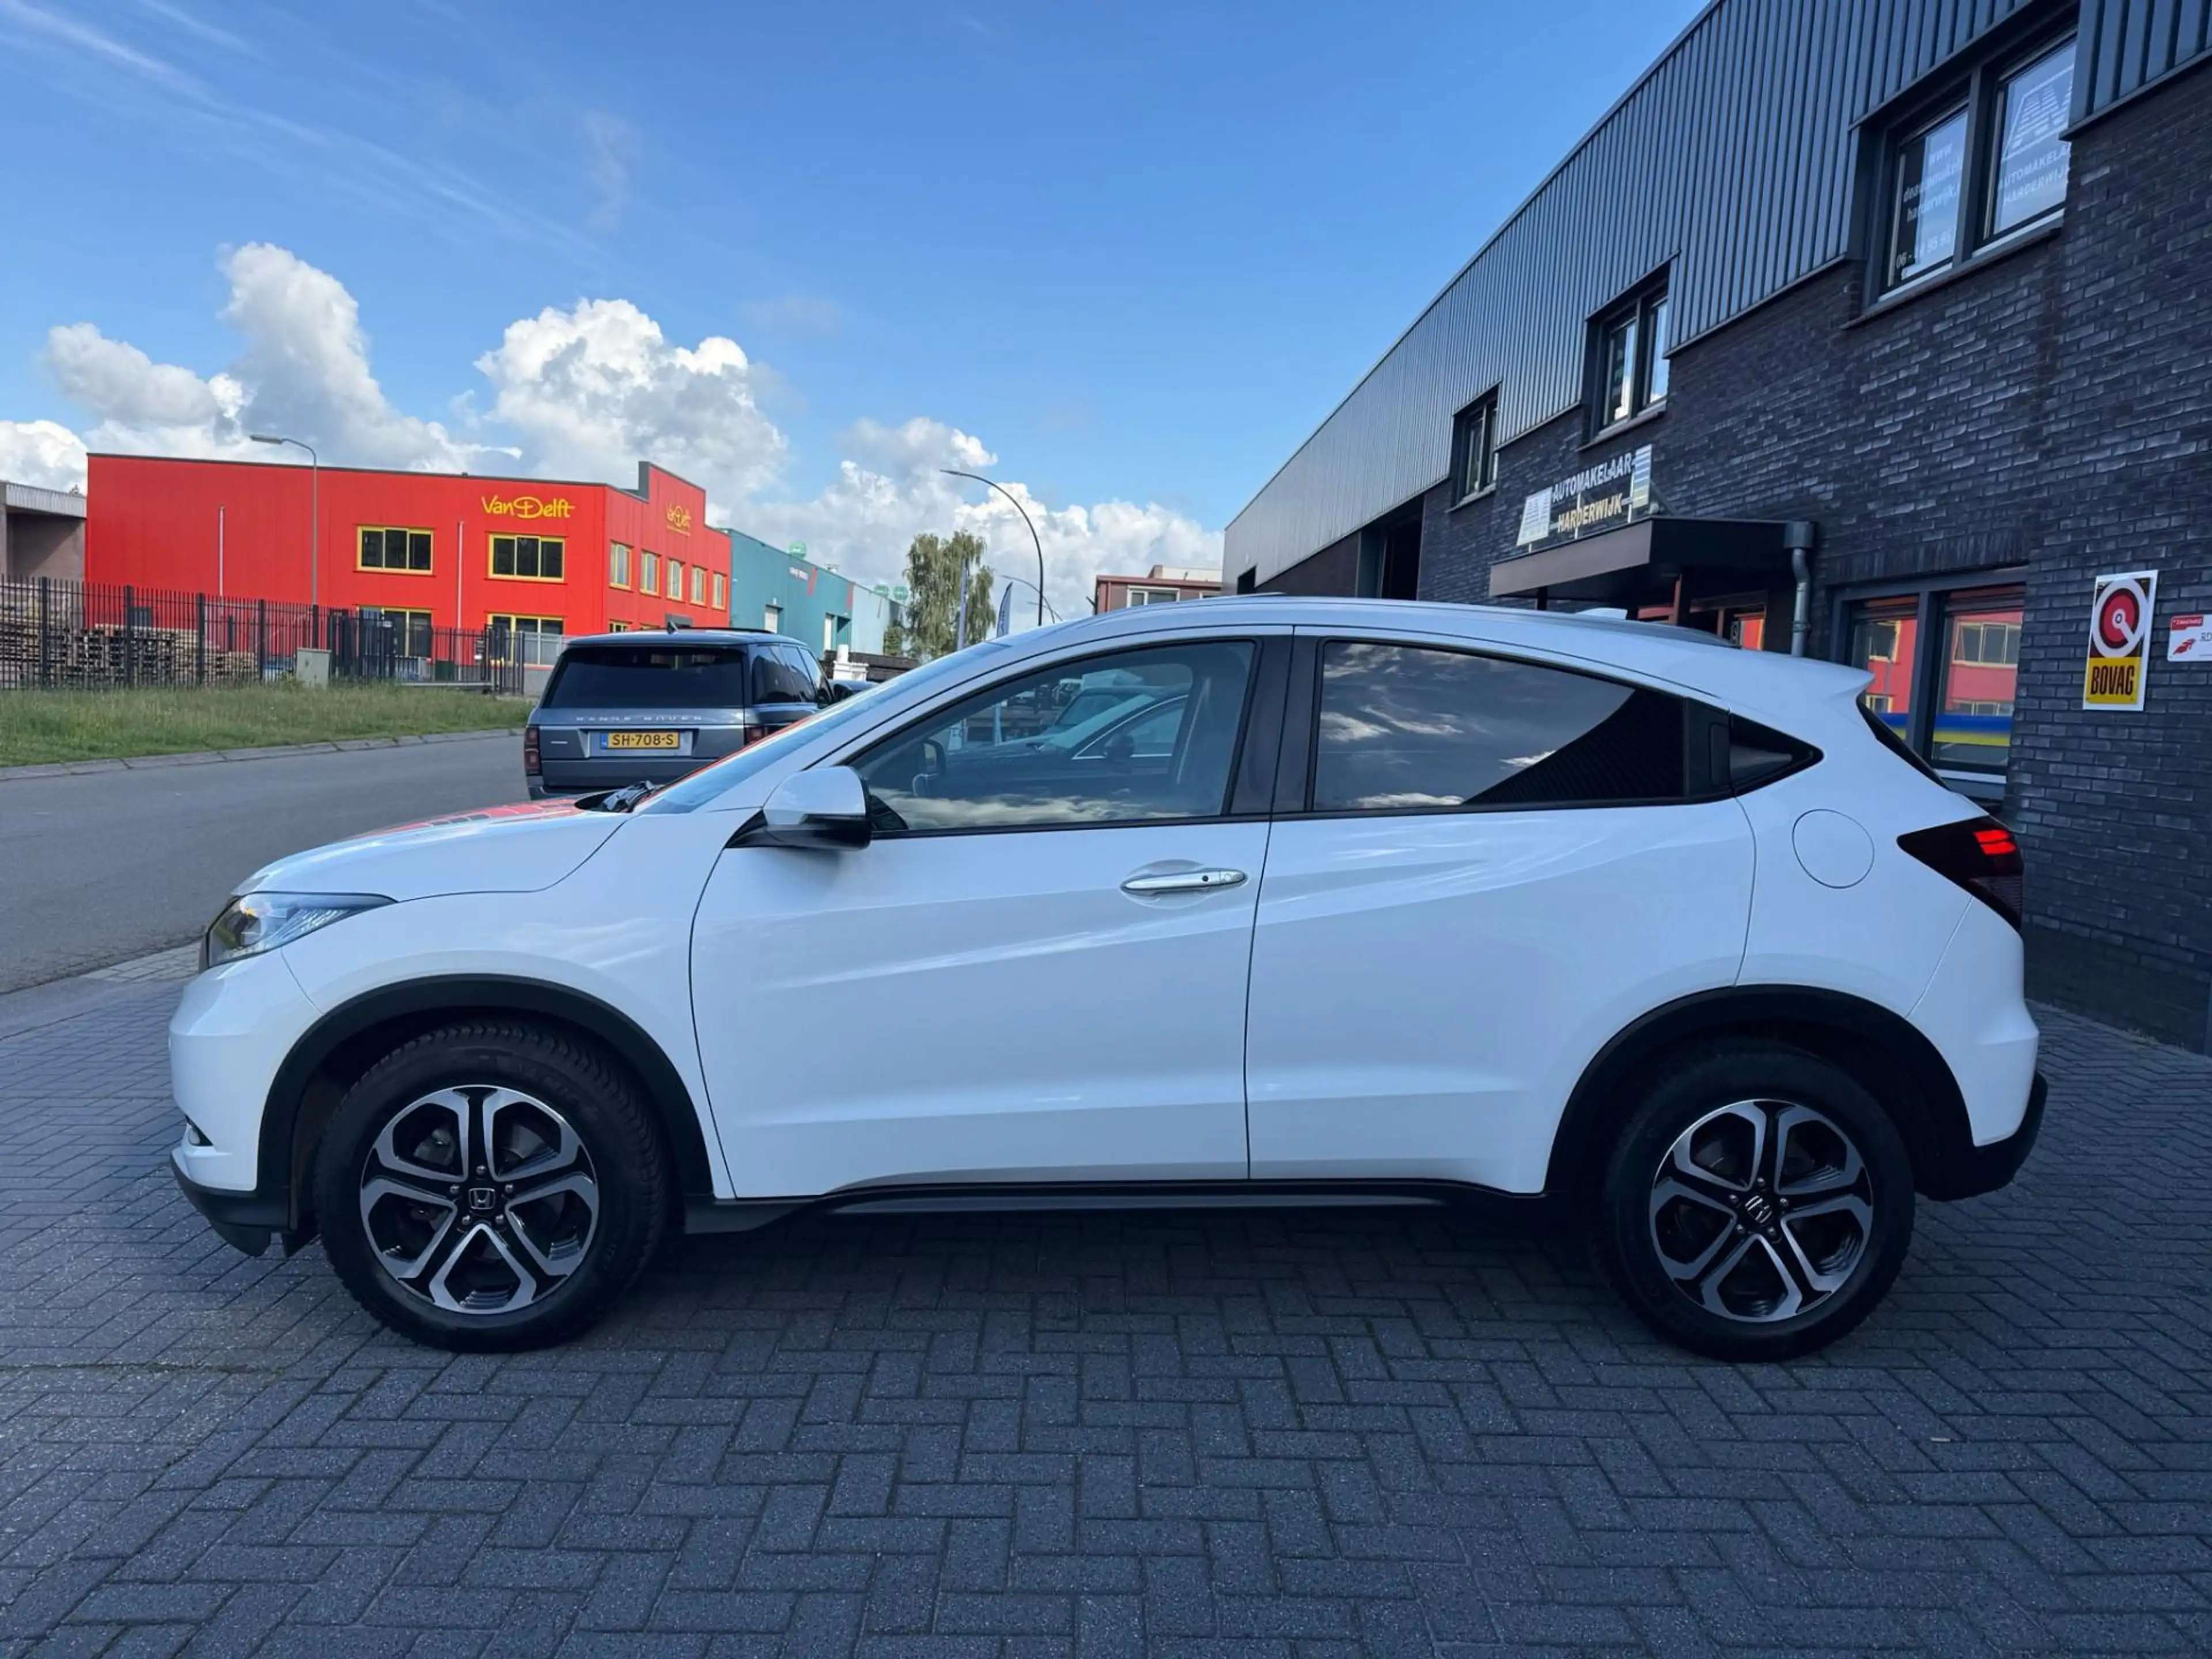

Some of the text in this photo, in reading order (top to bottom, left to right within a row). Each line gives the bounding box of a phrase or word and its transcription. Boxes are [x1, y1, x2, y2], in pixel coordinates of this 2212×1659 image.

[1552, 452, 1633, 503] AUTOMAKELAAR
[1558, 492, 1623, 533] HARDERWIJK
[2090, 665, 2135, 696] BOVAG
[612, 734, 674, 745] SH-708-S
